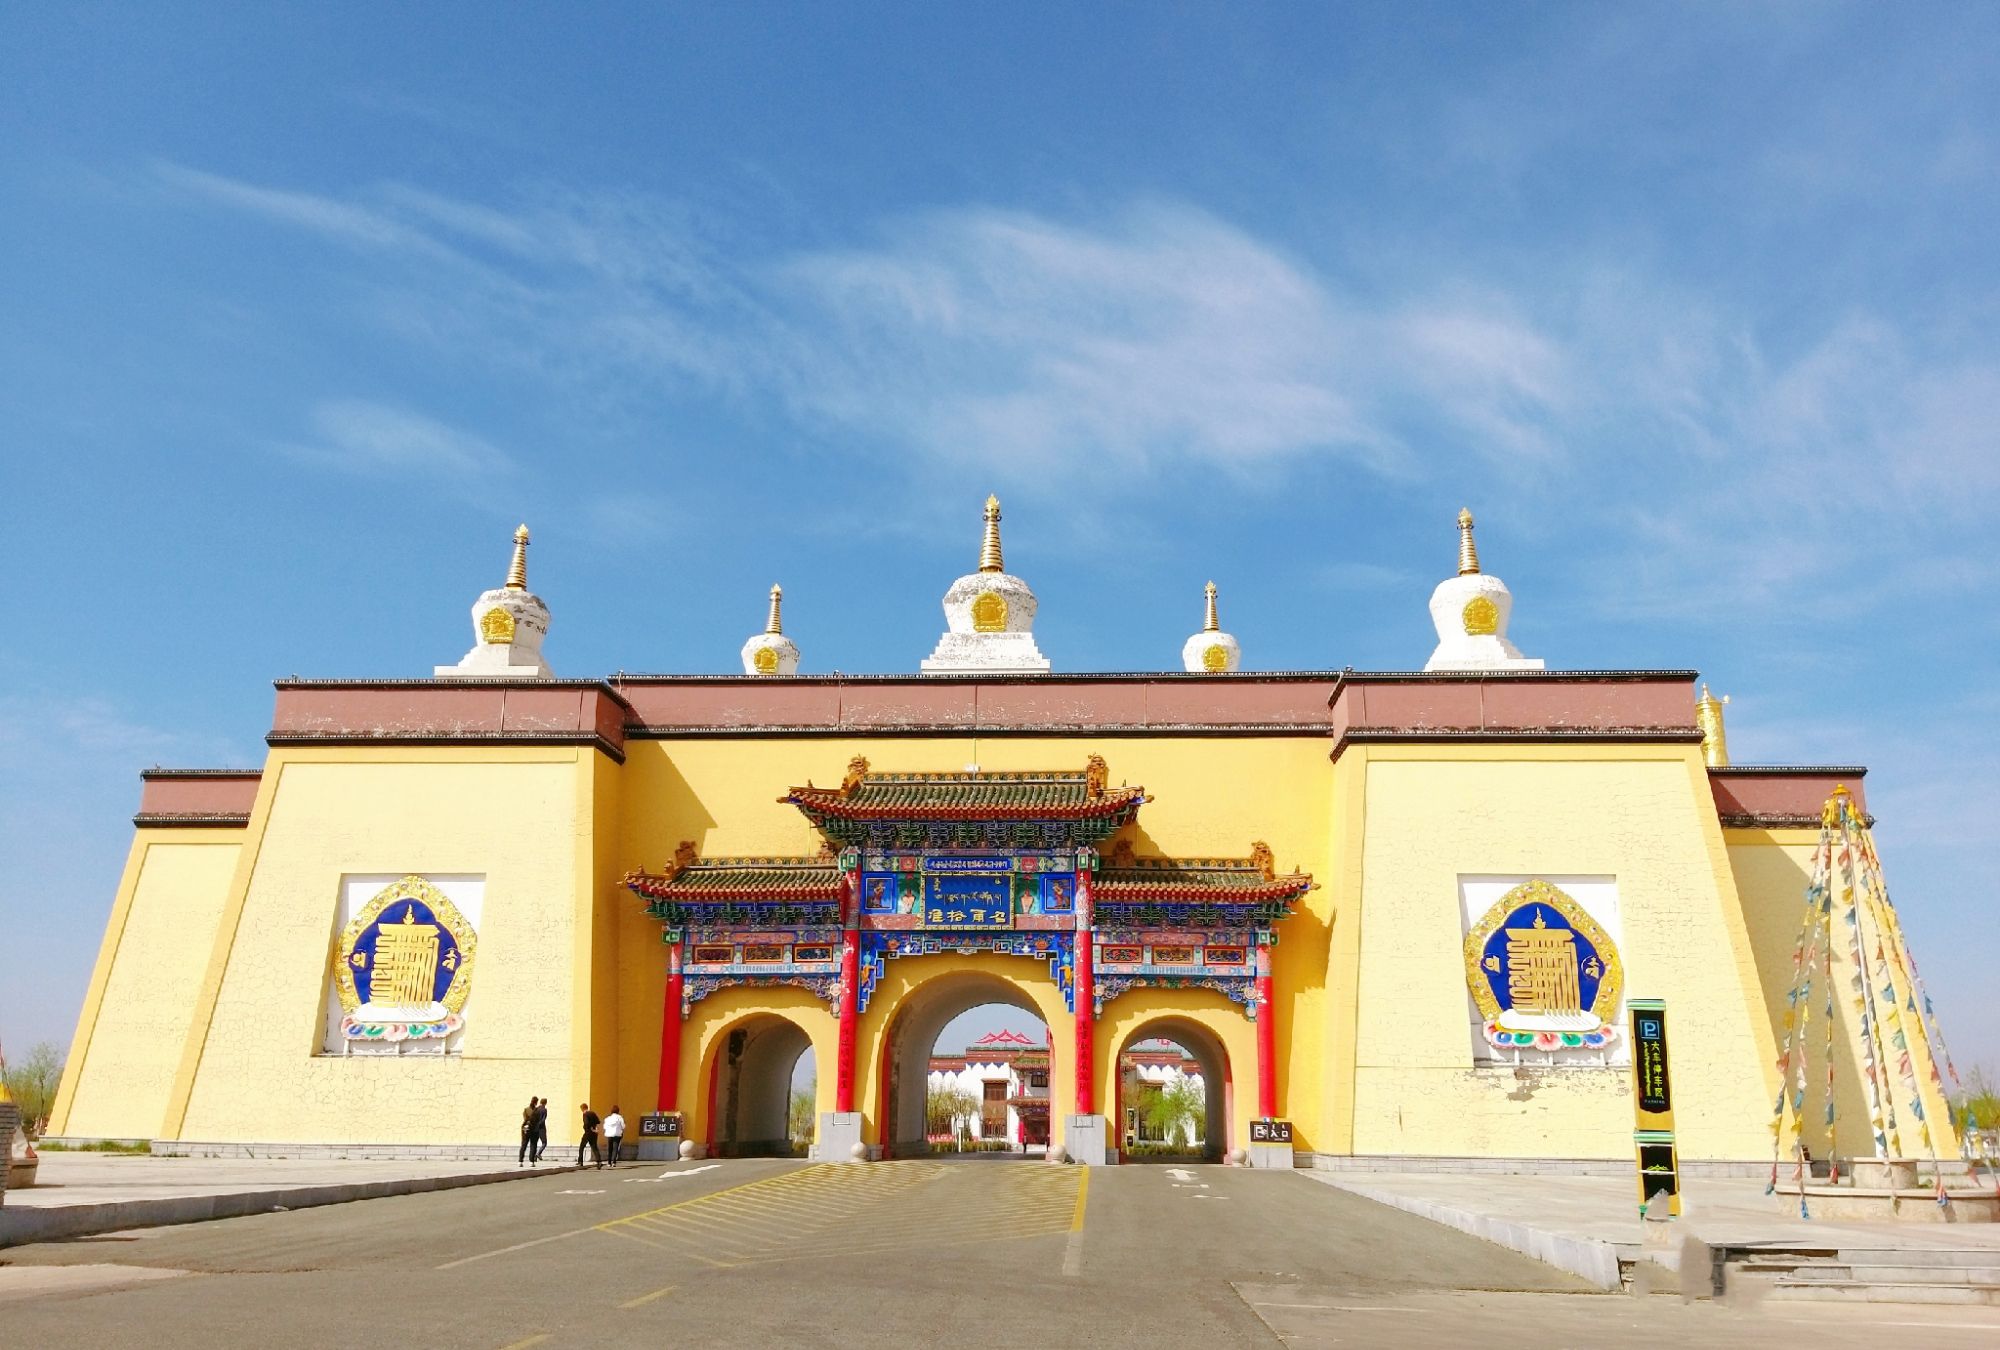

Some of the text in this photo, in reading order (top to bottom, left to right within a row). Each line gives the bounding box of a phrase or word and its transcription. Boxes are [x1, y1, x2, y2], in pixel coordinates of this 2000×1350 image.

[1644, 1022, 1657, 1037] P
[658, 1123, 676, 1132] 出口
[1270, 1129, 1289, 1138] 入口
